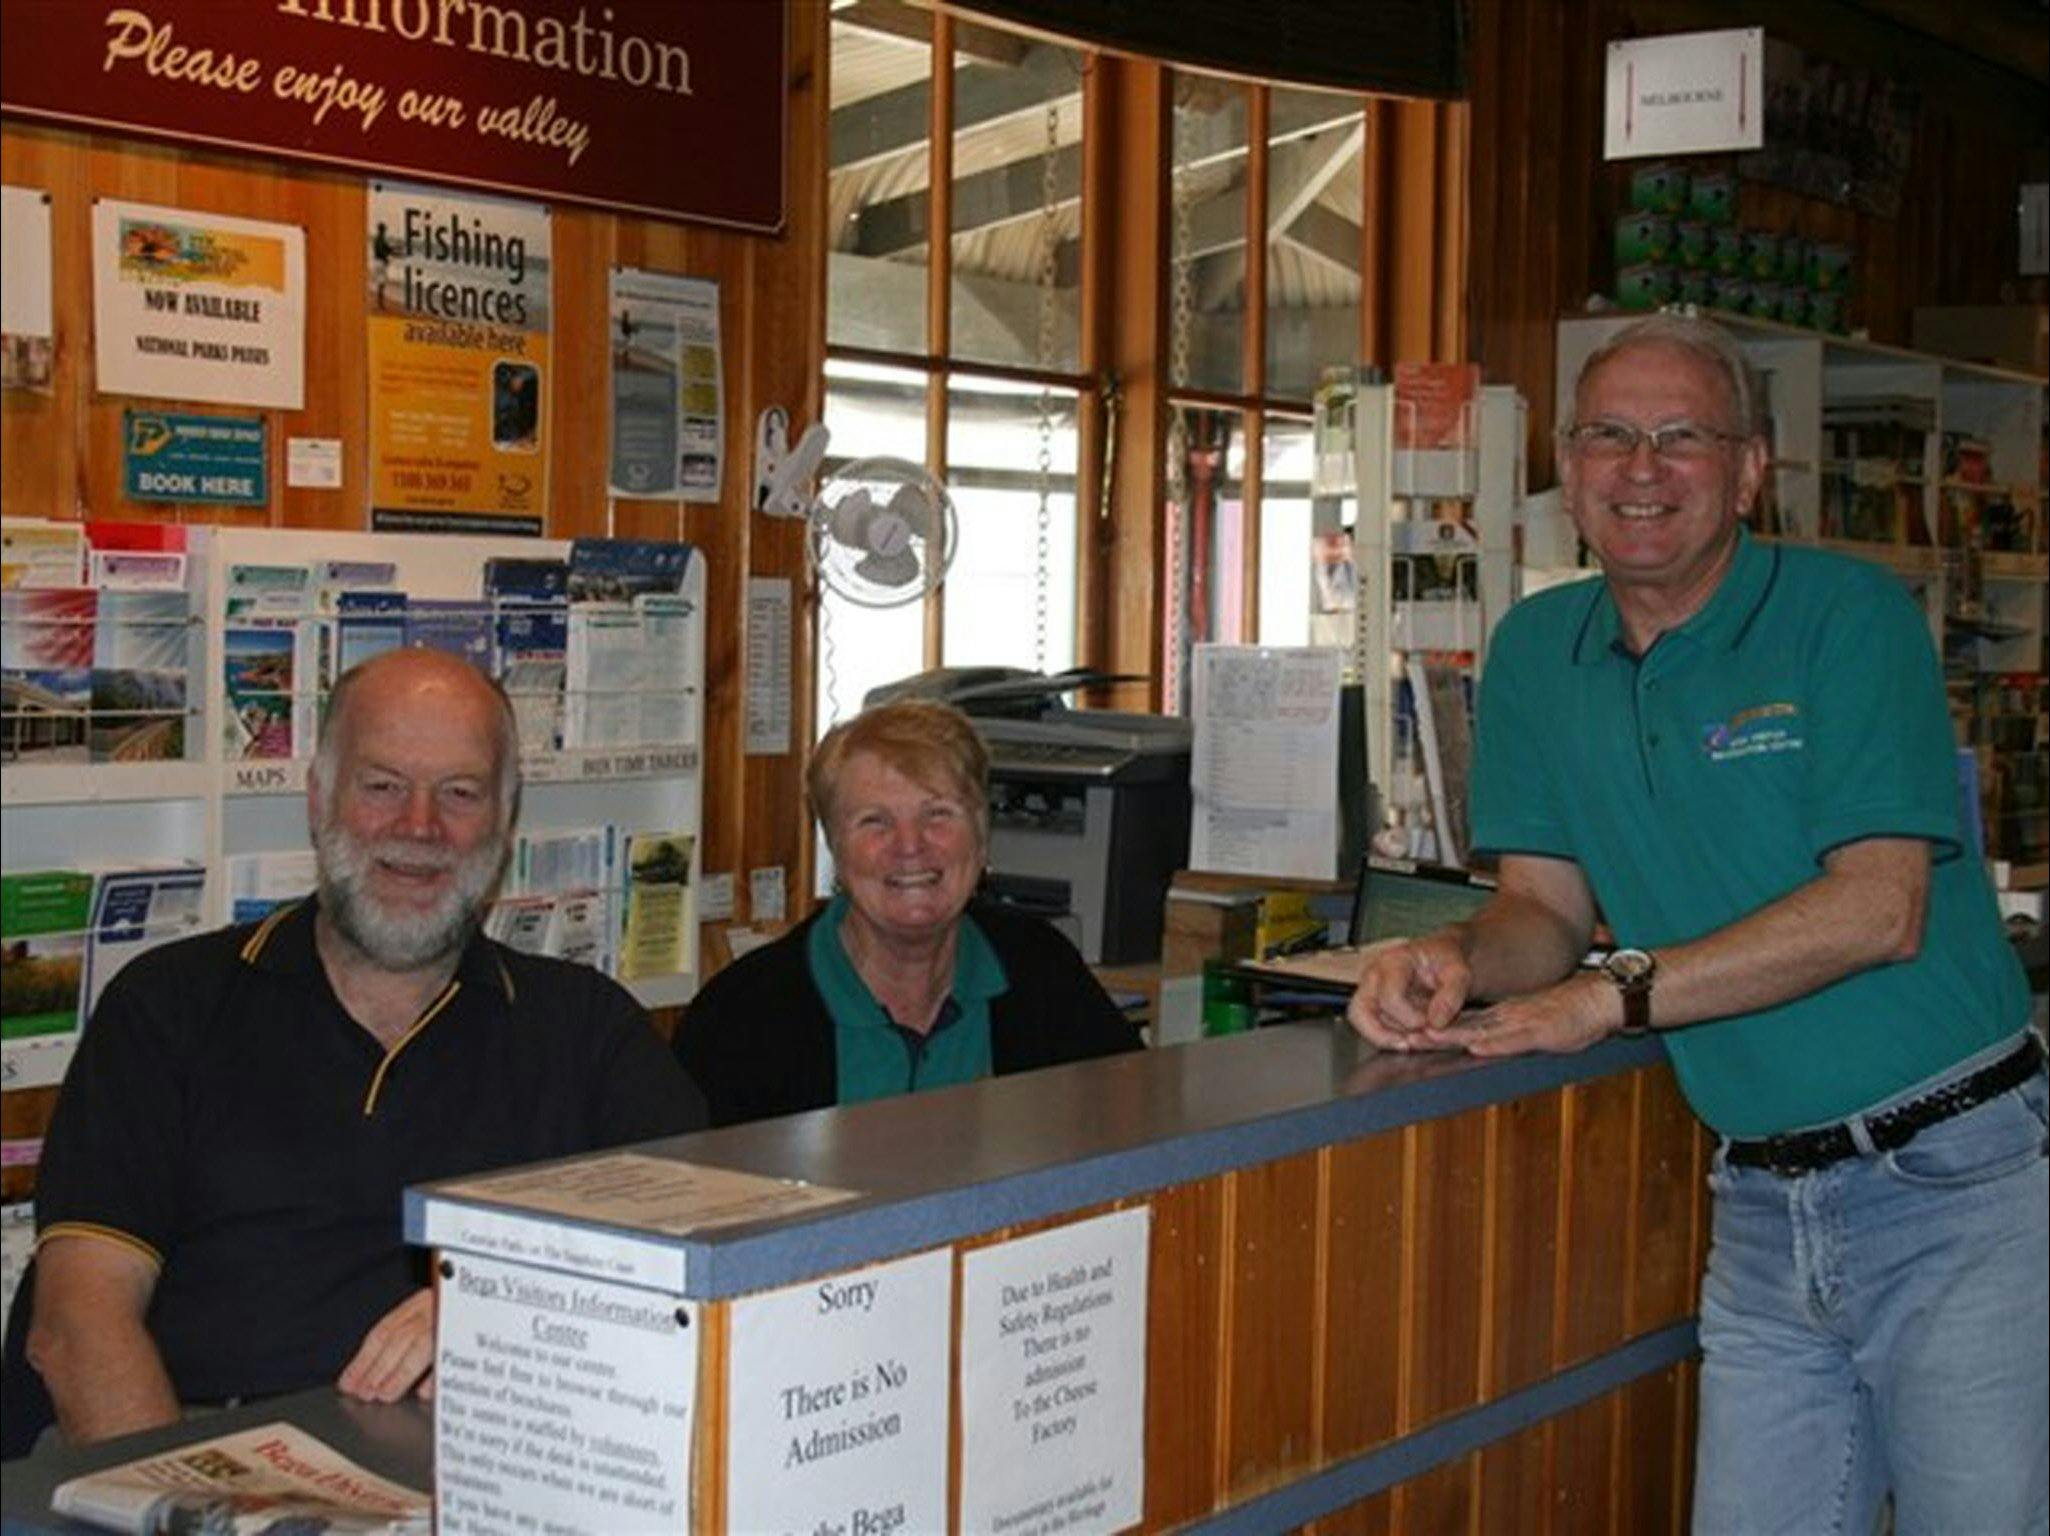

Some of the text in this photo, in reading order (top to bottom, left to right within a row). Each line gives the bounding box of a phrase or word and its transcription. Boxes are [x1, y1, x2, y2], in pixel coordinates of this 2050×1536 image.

[276, 0, 694, 96] normation
[103, 9, 592, 167] Please enjoy our valley
[404, 207, 526, 286] Fishing
[144, 289, 260, 323] NOW AVAILABLE
[404, 264, 528, 325] licences
[403, 323, 485, 350] available
[138, 472, 255, 498] BOOK HERE
[236, 768, 287, 787] MAPS
[458, 1266, 498, 1298] Bega
[501, 1275, 567, 1311] Visitors
[818, 1279, 880, 1315] Sorry
[1001, 1256, 1114, 1307] Due to Health and
[999, 1291, 1114, 1338] Safety Regulations
[1023, 1336, 1058, 1359] There
[779, 1358, 908, 1420] There is No
[1025, 1354, 1086, 1388] admission
[1013, 1380, 1098, 1422] To the Cheese
[784, 1411, 902, 1470] Admission
[1031, 1414, 1078, 1445] Factory
